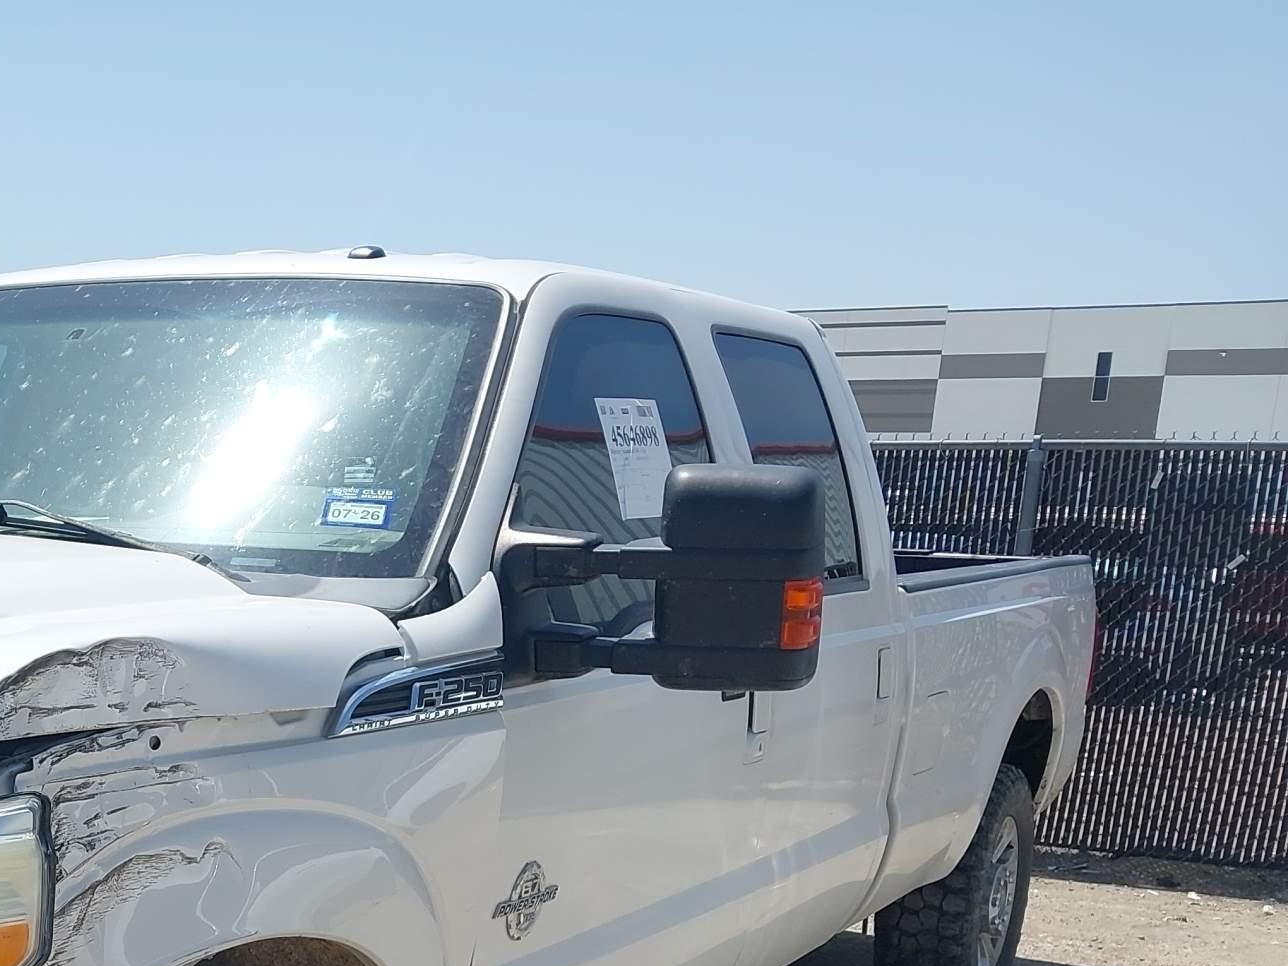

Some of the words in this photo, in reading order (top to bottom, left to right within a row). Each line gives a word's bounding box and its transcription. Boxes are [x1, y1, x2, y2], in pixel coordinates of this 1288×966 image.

[612, 425, 660, 447] 45646898
[414, 672, 504, 711] F-250
[415, 708, 460, 721] SUPER
[466, 701, 500, 714] DUTY
[498, 898, 530, 916] POWER
[528, 887, 559, 908] STROKE
